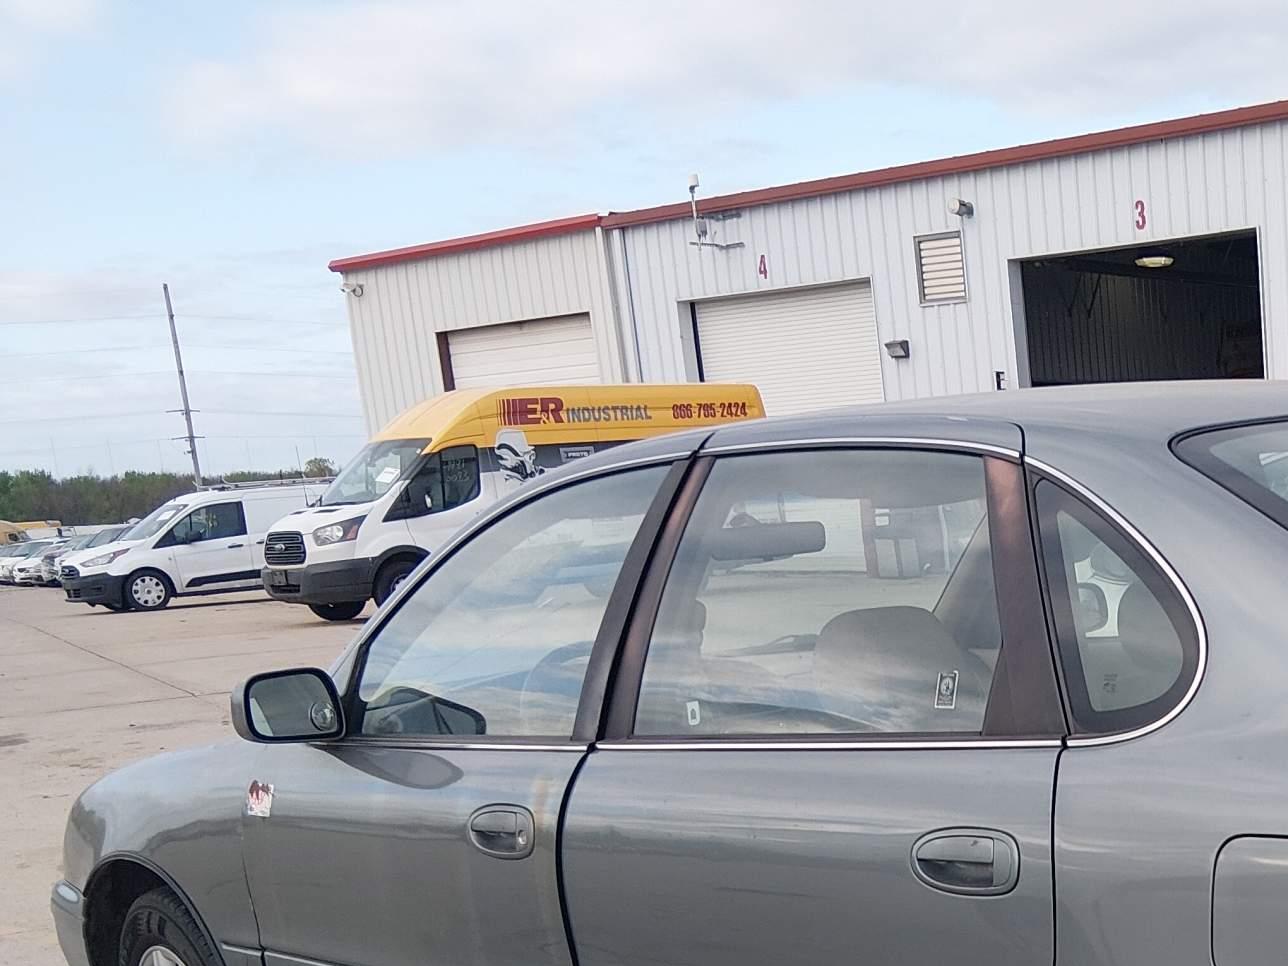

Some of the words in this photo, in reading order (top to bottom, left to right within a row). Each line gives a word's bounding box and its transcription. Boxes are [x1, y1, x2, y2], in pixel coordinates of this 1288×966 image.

[1135, 199, 1147, 231] 3
[757, 253, 769, 280] 4
[566, 404, 652, 423] INDUSTRIAL
